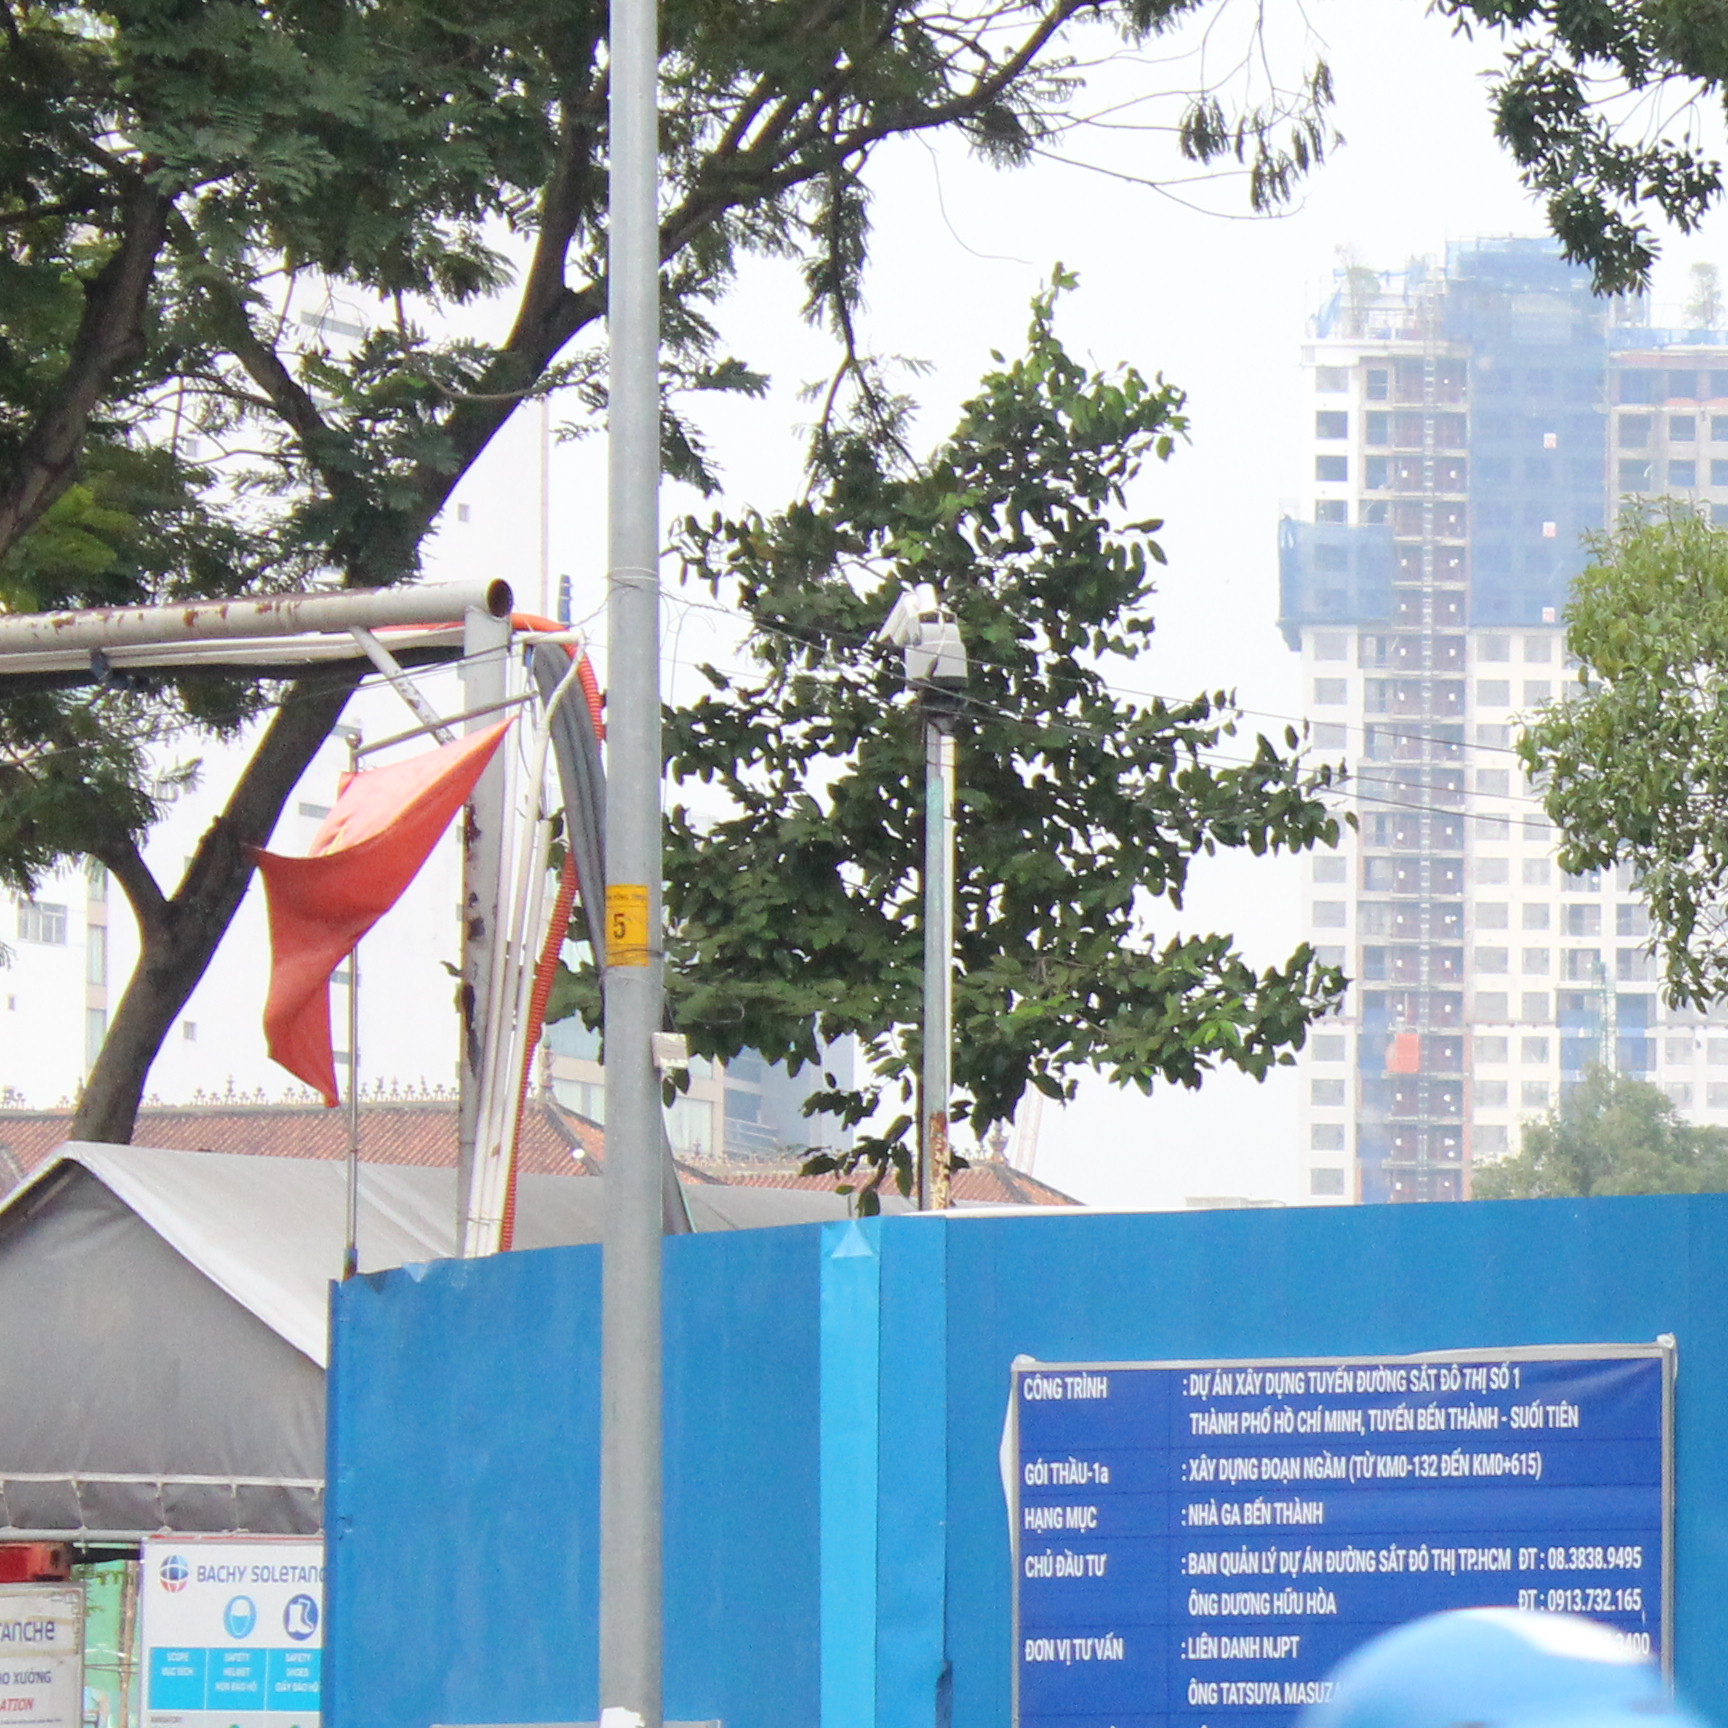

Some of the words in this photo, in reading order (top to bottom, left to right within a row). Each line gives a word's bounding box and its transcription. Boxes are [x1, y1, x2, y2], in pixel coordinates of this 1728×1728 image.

[1024, 1374, 1062, 1400] CÔNG
[1065, 1372, 1108, 1399] TRÌNH
[1190, 1373, 1211, 1400] DỰ
[1212, 1369, 1232, 1396] ÁN
[1235, 1368, 1263, 1396] XÂY
[1265, 1372, 1304, 1400] DỰNG
[1307, 1364, 1351, 1394] TUYẾN
[1356, 1365, 1407, 1393] ĐƯỜNG
[1410, 1364, 1438, 1392] SẮT
[1440, 1364, 1461, 1391] ĐÔ
[1463, 1367, 1487, 1394] THỊ
[1489, 1361, 1511, 1390] SỐ
[1512, 1367, 1521, 1390] 1
[1189, 1407, 1238, 1435] THÀNH
[1241, 1405, 1271, 1434] PHỐ
[1274, 1404, 1294, 1433] HỒ
[1297, 1405, 1322, 1433] CHÍ
[1324, 1410, 1365, 1436] MINH,
[1368, 1402, 1414, 1431] TUYẾN
[1417, 1401, 1445, 1431] BẾN
[1447, 1401, 1499, 1430] THÀNH
[1510, 1399, 1544, 1429] SUỐI
[1546, 1399, 1579, 1428] TIÊN
[1024, 1458, 1048, 1486] GÓI
[1050, 1456, 1110, 1485] THẦU-1a
[1189, 1454, 1217, 1481] XÂY
[1219, 1458, 1258, 1485] DỰNG
[1261, 1457, 1300, 1484] ĐOẠN
[1303, 1449, 1346, 1480] NGẦM
[1349, 1450, 1374, 1484] (TỪ
[1376, 1454, 1438, 1478] KM0-132
[1441, 1447, 1470, 1477] ĐẾN
[1024, 1506, 1063, 1533] HẠNG
[1066, 1506, 1097, 1533] MỤC
[1188, 1498, 1219, 1526] NHÀ
[1221, 1503, 1241, 1525] GA
[1243, 1496, 1272, 1525] BẾN
[1273, 1497, 1324, 1525] THÀNH
[197, 1565, 247, 1583] BACHY
[1025, 1548, 1052, 1578] CHỦ
[1055, 1549, 1084, 1577] ĐẦU
[1086, 1554, 1107, 1577] TƯ
[1188, 1552, 1217, 1575] BAN
[1220, 1544, 1259, 1577] QUẢN
[1261, 1546, 1278, 1574] LÝ
[1279, 1550, 1301, 1579] DỰ
[1302, 1546, 1323, 1573] ÁN
[1325, 1545, 1376, 1573] ĐƯỜNG
[1378, 1542, 1406, 1573] SẮT
[1408, 1544, 1429, 1572] ĐÔ
[1431, 1548, 1457, 1576] THỊ
[1458, 1547, 1512, 1571] TP.HCM
[1518, 1547, 1538, 1570] ĐT
[1547, 1546, 1642, 1570] 08.3838.9495
[1188, 1588, 1219, 1616] ÔNG
[1220, 1591, 1270, 1616] DƯƠNG
[1273, 1586, 1303, 1615] HỮU
[1306, 1586, 1337, 1615] HÒA
[1518, 1588, 1538, 1611] ĐT
[1547, 1588, 1642, 1612] 0913.732.165
[1025, 1638, 1054, 1661] ĐƠN
[1056, 1638, 1071, 1666] VỊ
[1073, 1638, 1094, 1661] TƯ
[1094, 1632, 1124, 1660] VẤN
[1188, 1632, 1218, 1659] LIÊN
[1221, 1636, 1260, 1659] DANH
[1263, 1636, 1300, 1659] NJPT
[1188, 1677, 1219, 1706] ÔNG
[1220, 1682, 1281, 1705] TATSUYA
